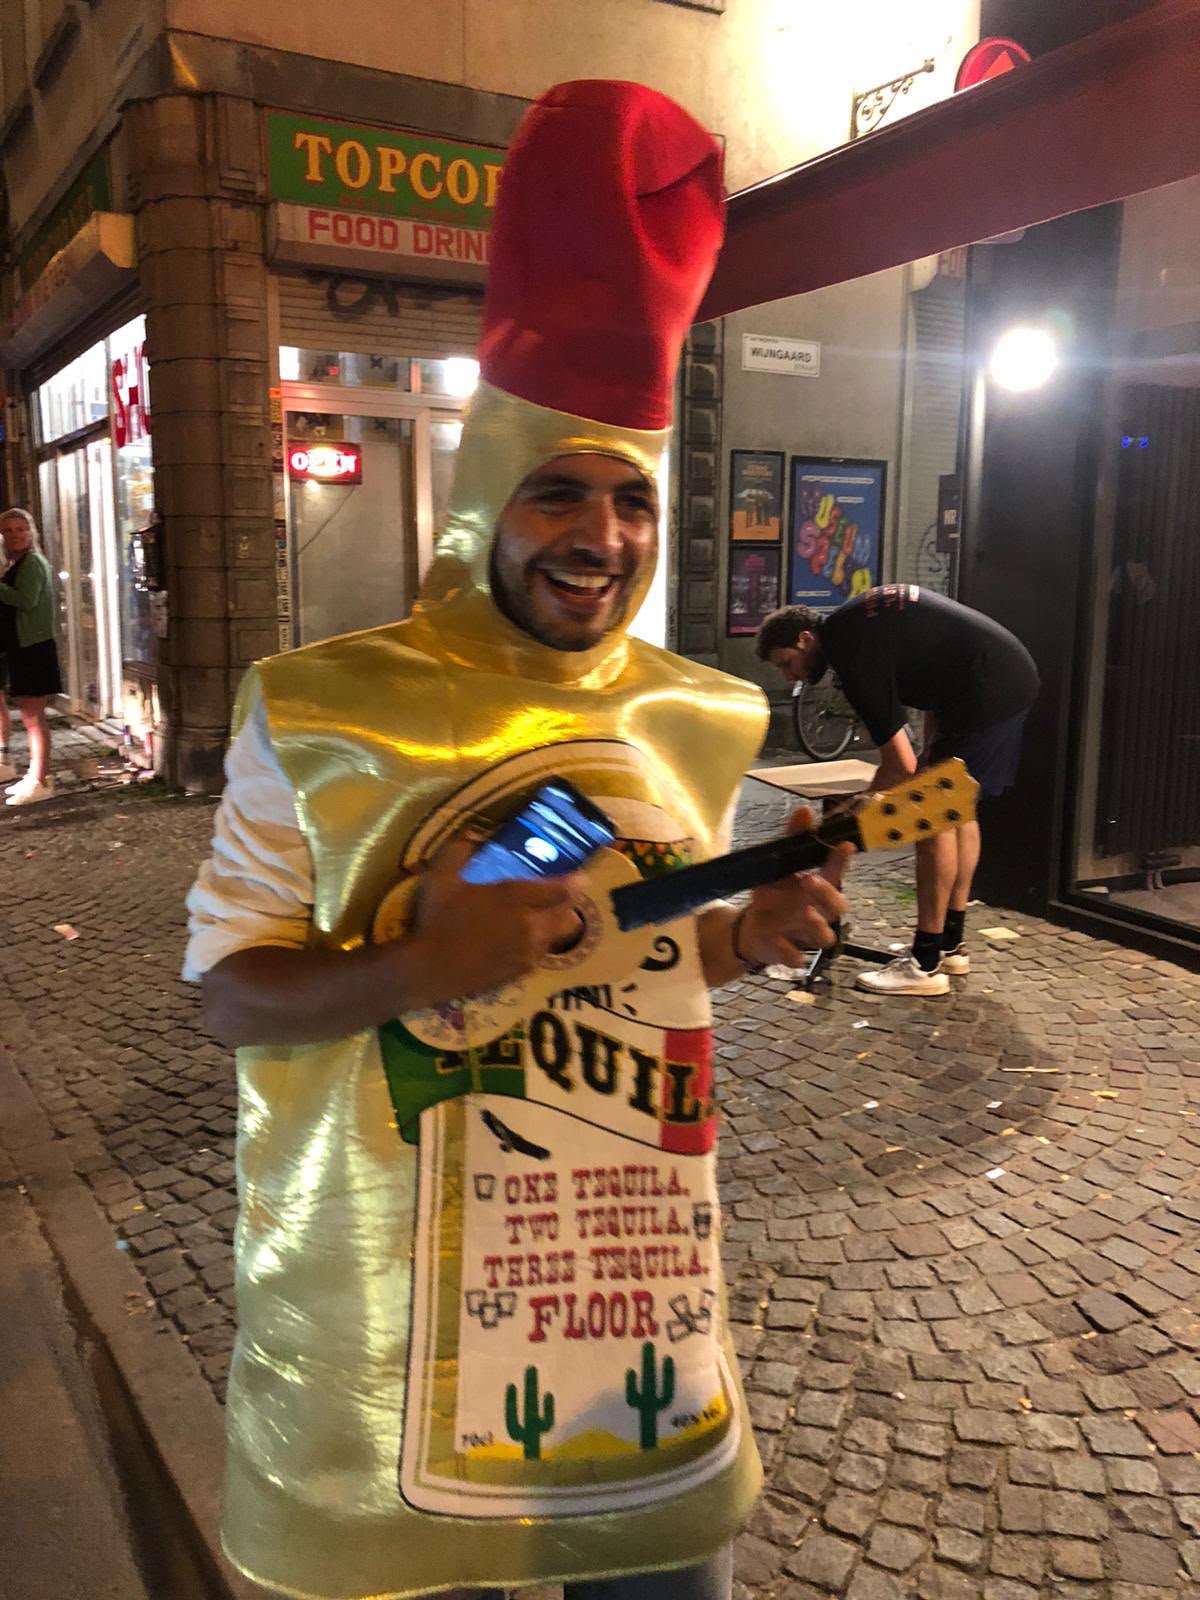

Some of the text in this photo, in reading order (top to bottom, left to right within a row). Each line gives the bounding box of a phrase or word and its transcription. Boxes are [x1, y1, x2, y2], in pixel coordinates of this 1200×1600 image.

[307, 209, 399, 251] FOOD
[751, 347, 812, 363] WIJNGAARD
[504, 1172, 558, 1204] ONE
[504, 1211, 559, 1245] TWO
[484, 1249, 576, 1289] THREE
[528, 1290, 660, 1343] FLOOR
